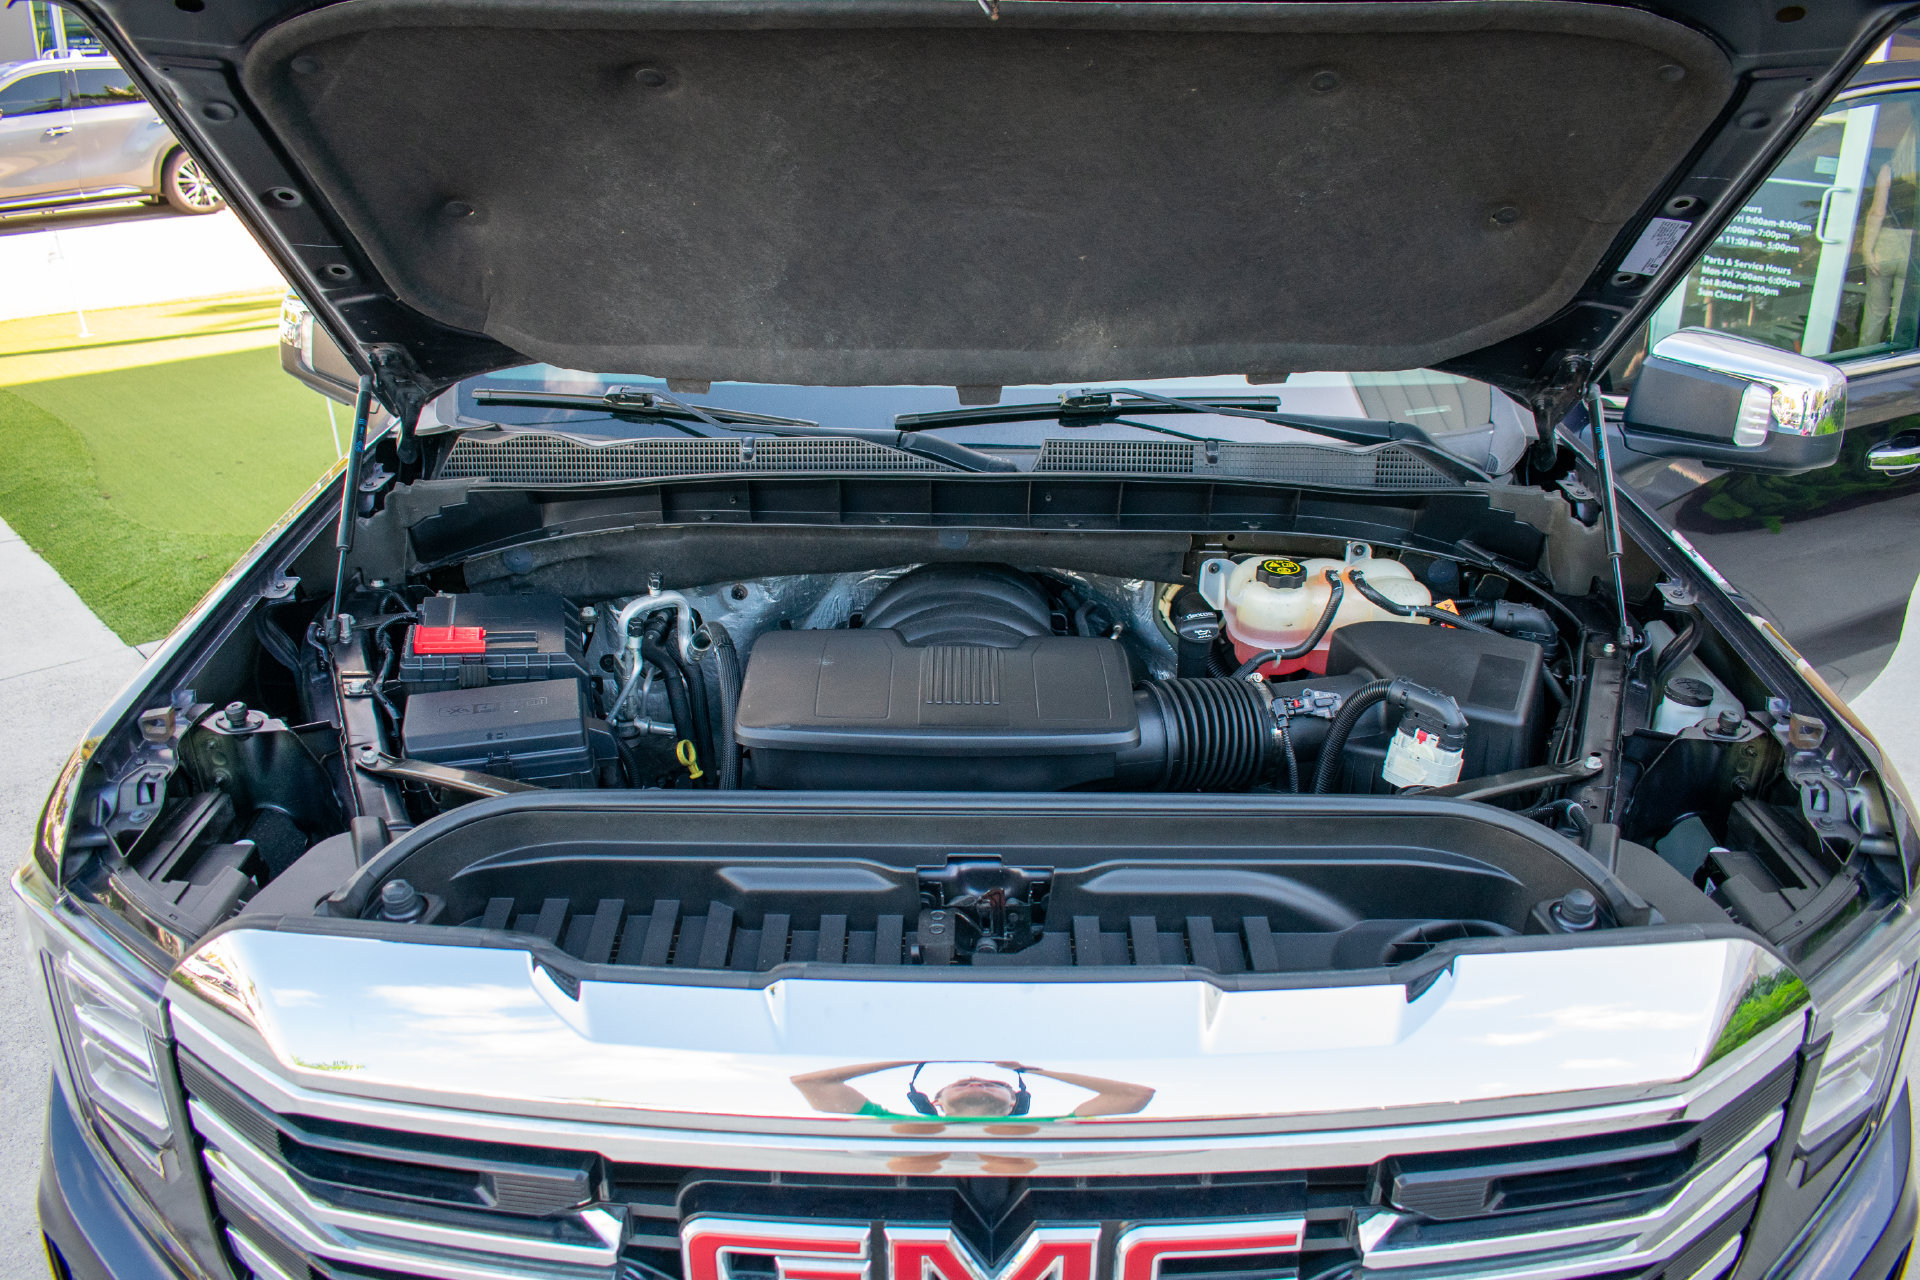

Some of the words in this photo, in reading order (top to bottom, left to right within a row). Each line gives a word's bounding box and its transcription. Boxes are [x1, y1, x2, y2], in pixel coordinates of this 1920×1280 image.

[1741, 205, 1763, 214] ours
[1745, 215, 1812, 232] 9:00am-8:00pm
[1725, 235, 1749, 246] 11:00
[1767, 242, 1800, 254] 5:00pm
[1703, 255, 1725, 265] Parts
[1726, 258, 1733, 266] &
[1734, 259, 1764, 271] Service
[1765, 263, 1792, 275] Hours
[1699, 277, 1713, 285] Sat
[1713, 278, 1780, 296] 8:00am-5:00pm
[1701, 266, 1734, 278] Mon-Fri
[1734, 271, 1801, 288] 7:00am-6:00pm
[1697, 287, 1714, 297] Sun
[1714, 289, 1743, 302] Closed
[681, 1217, 1306, 1280] GMC
